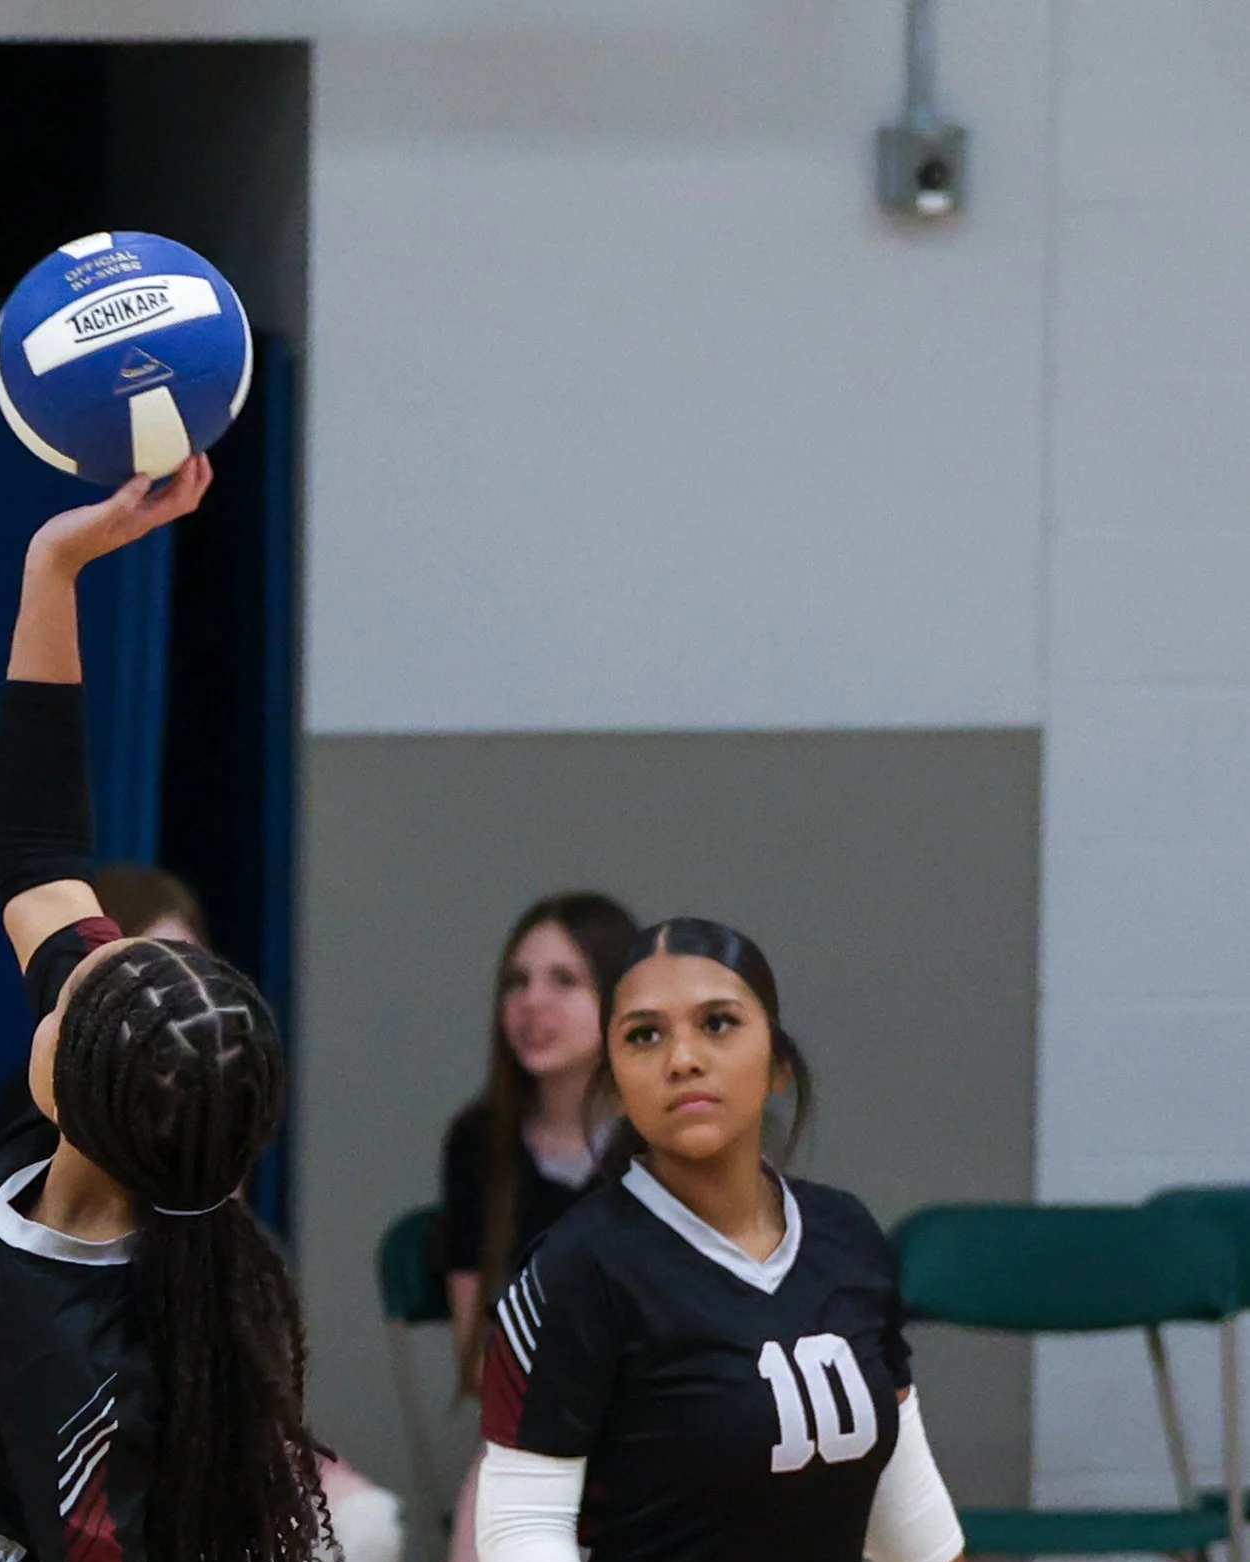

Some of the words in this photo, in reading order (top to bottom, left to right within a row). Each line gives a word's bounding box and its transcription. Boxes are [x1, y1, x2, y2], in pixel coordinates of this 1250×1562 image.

[64, 250, 139, 282] OFFICIAL
[70, 292, 170, 335] TACHIKARA
[757, 1332, 879, 1474] 10
